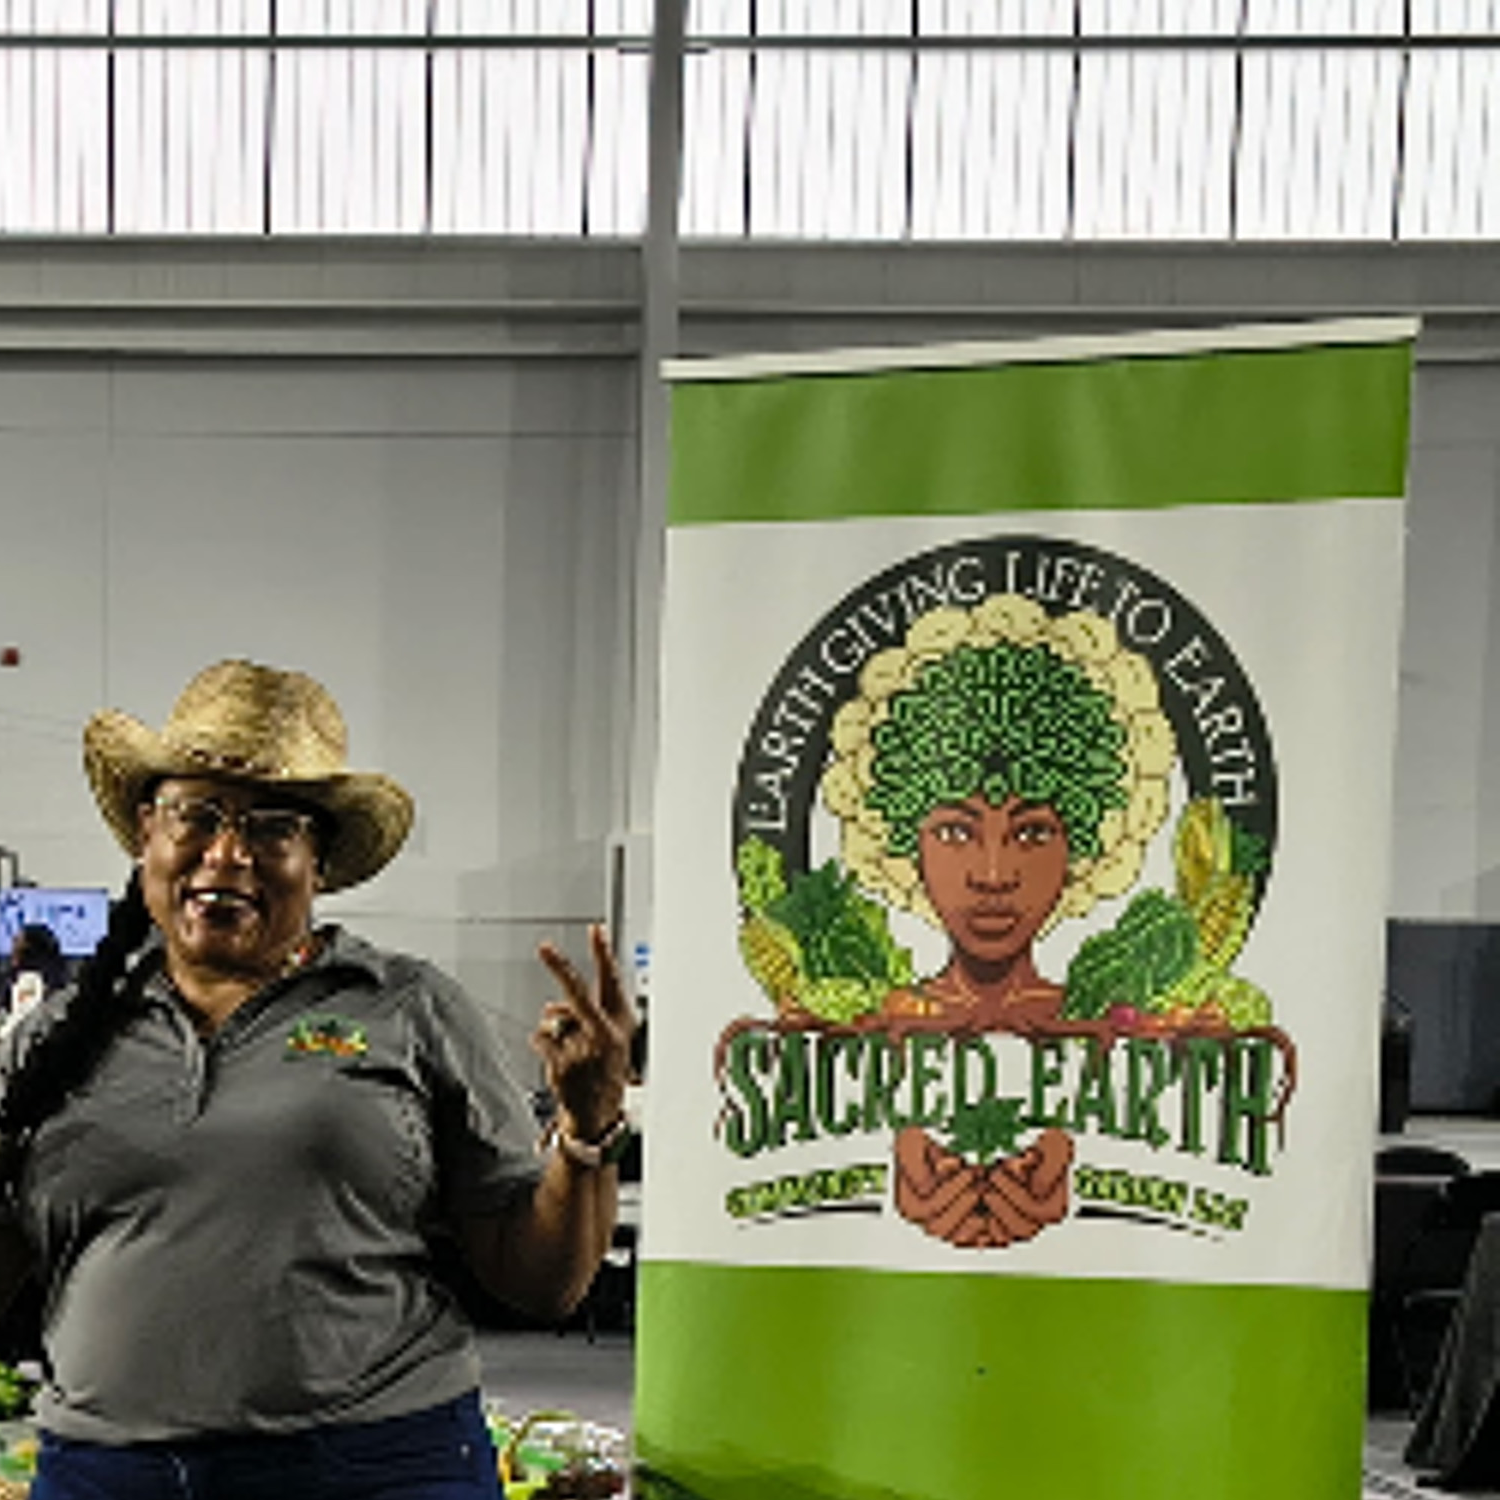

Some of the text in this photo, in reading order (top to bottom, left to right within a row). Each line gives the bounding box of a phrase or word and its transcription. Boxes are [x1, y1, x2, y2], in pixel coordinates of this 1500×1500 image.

[745, 550, 1258, 832] EARTH GIVING LIFE TO EARTH
[725, 1031, 1274, 1177] SACRED EARTH
